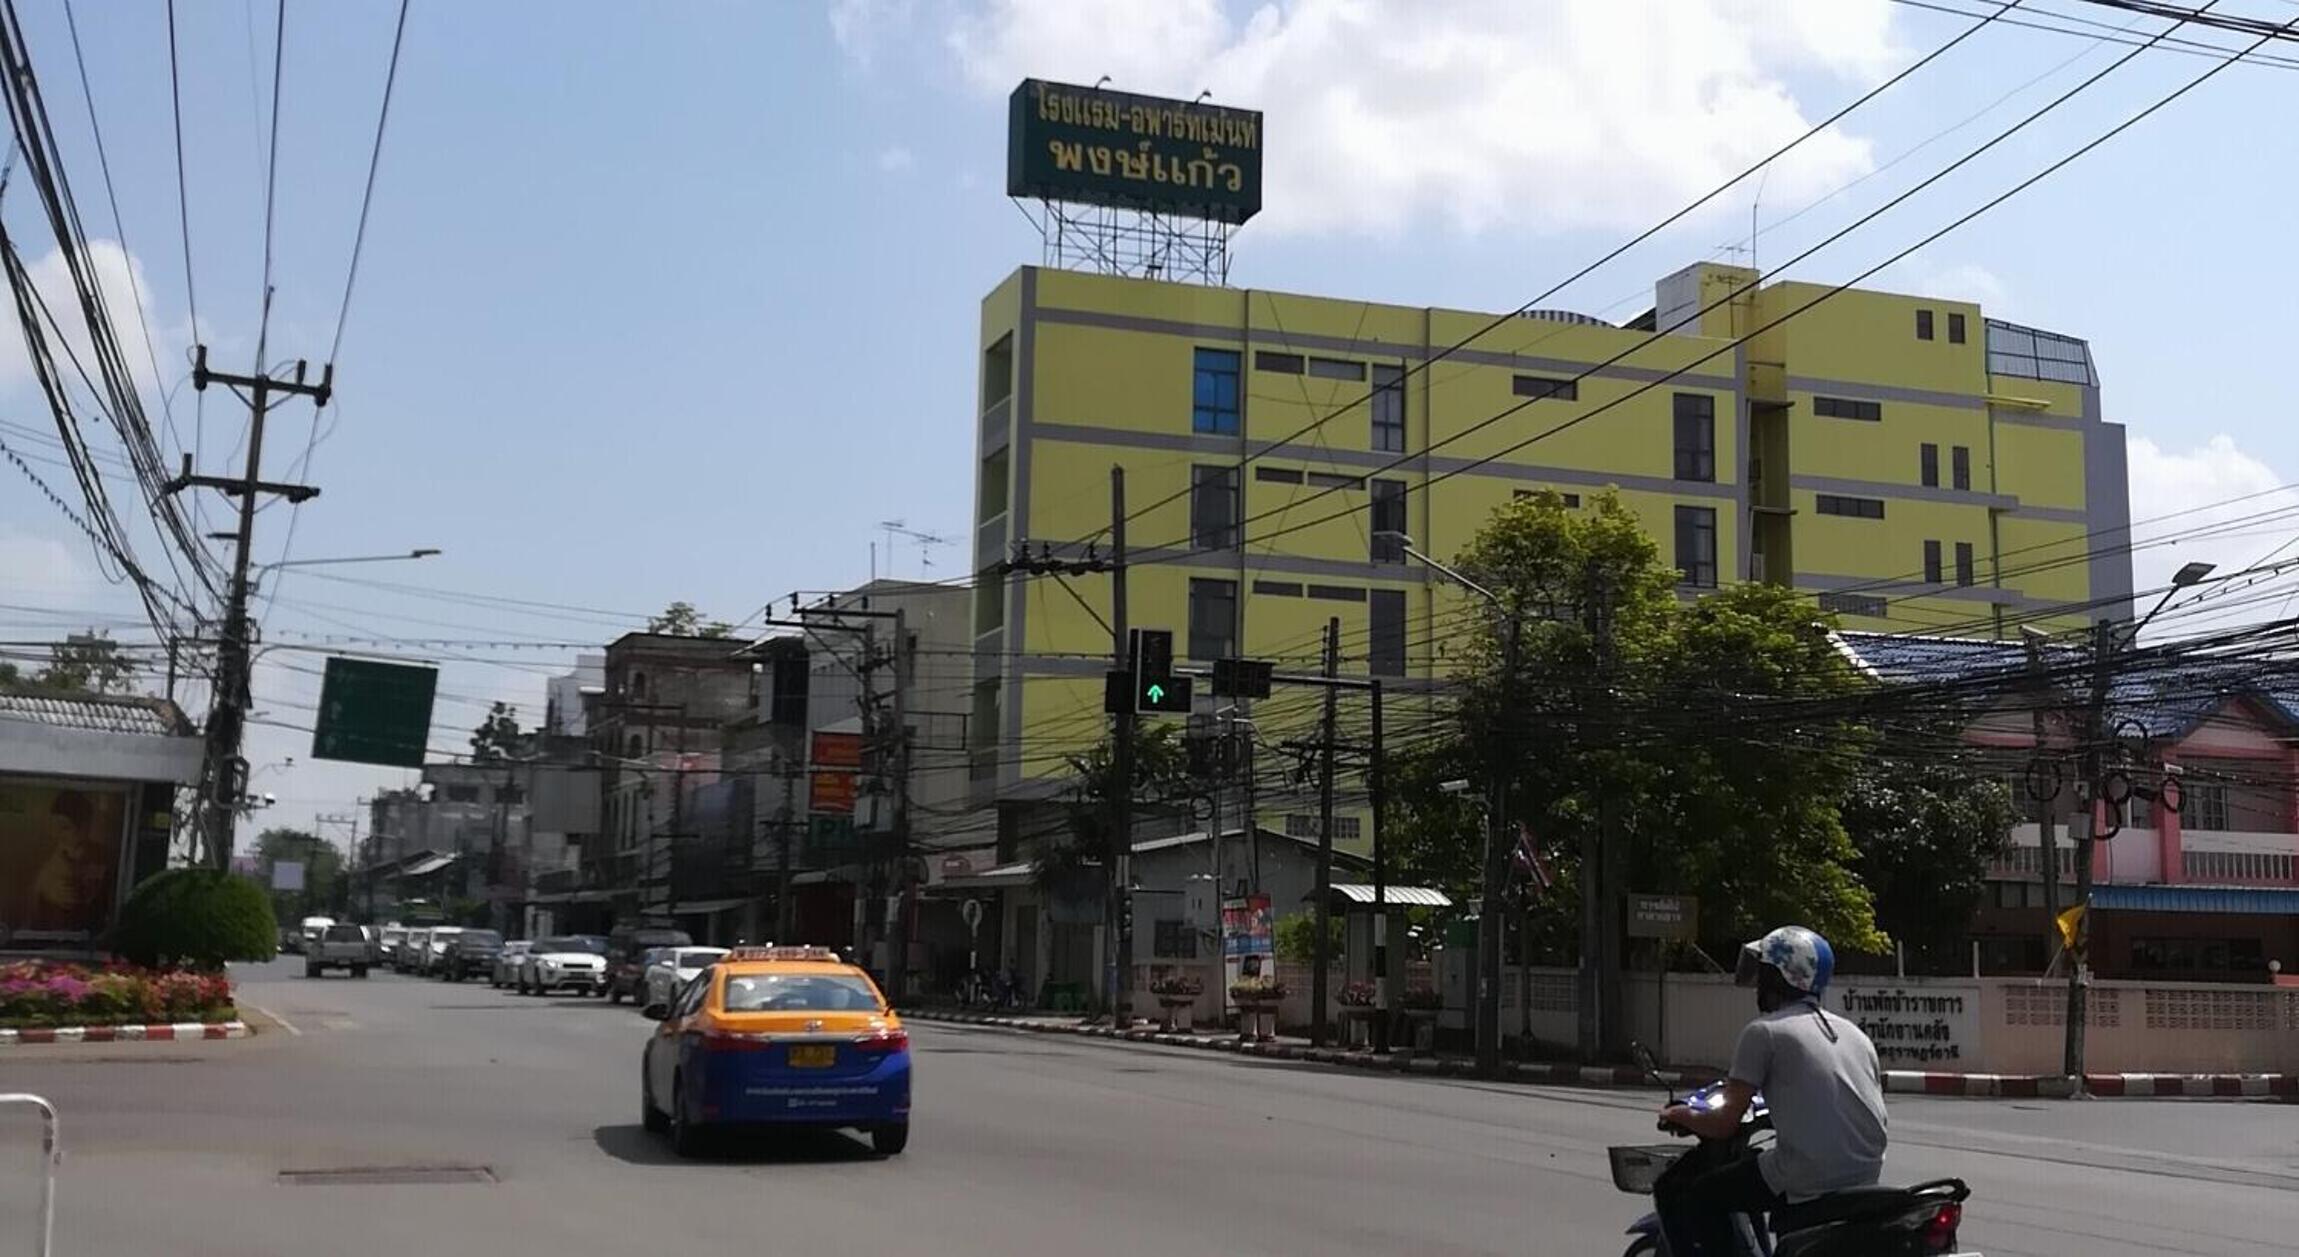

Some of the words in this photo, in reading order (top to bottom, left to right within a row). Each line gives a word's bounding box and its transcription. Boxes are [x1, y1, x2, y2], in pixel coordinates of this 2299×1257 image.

[1049, 138, 1243, 192] พงษ์แก้ว
[1842, 988, 1963, 1014] บ้านพักข้าราชการ
